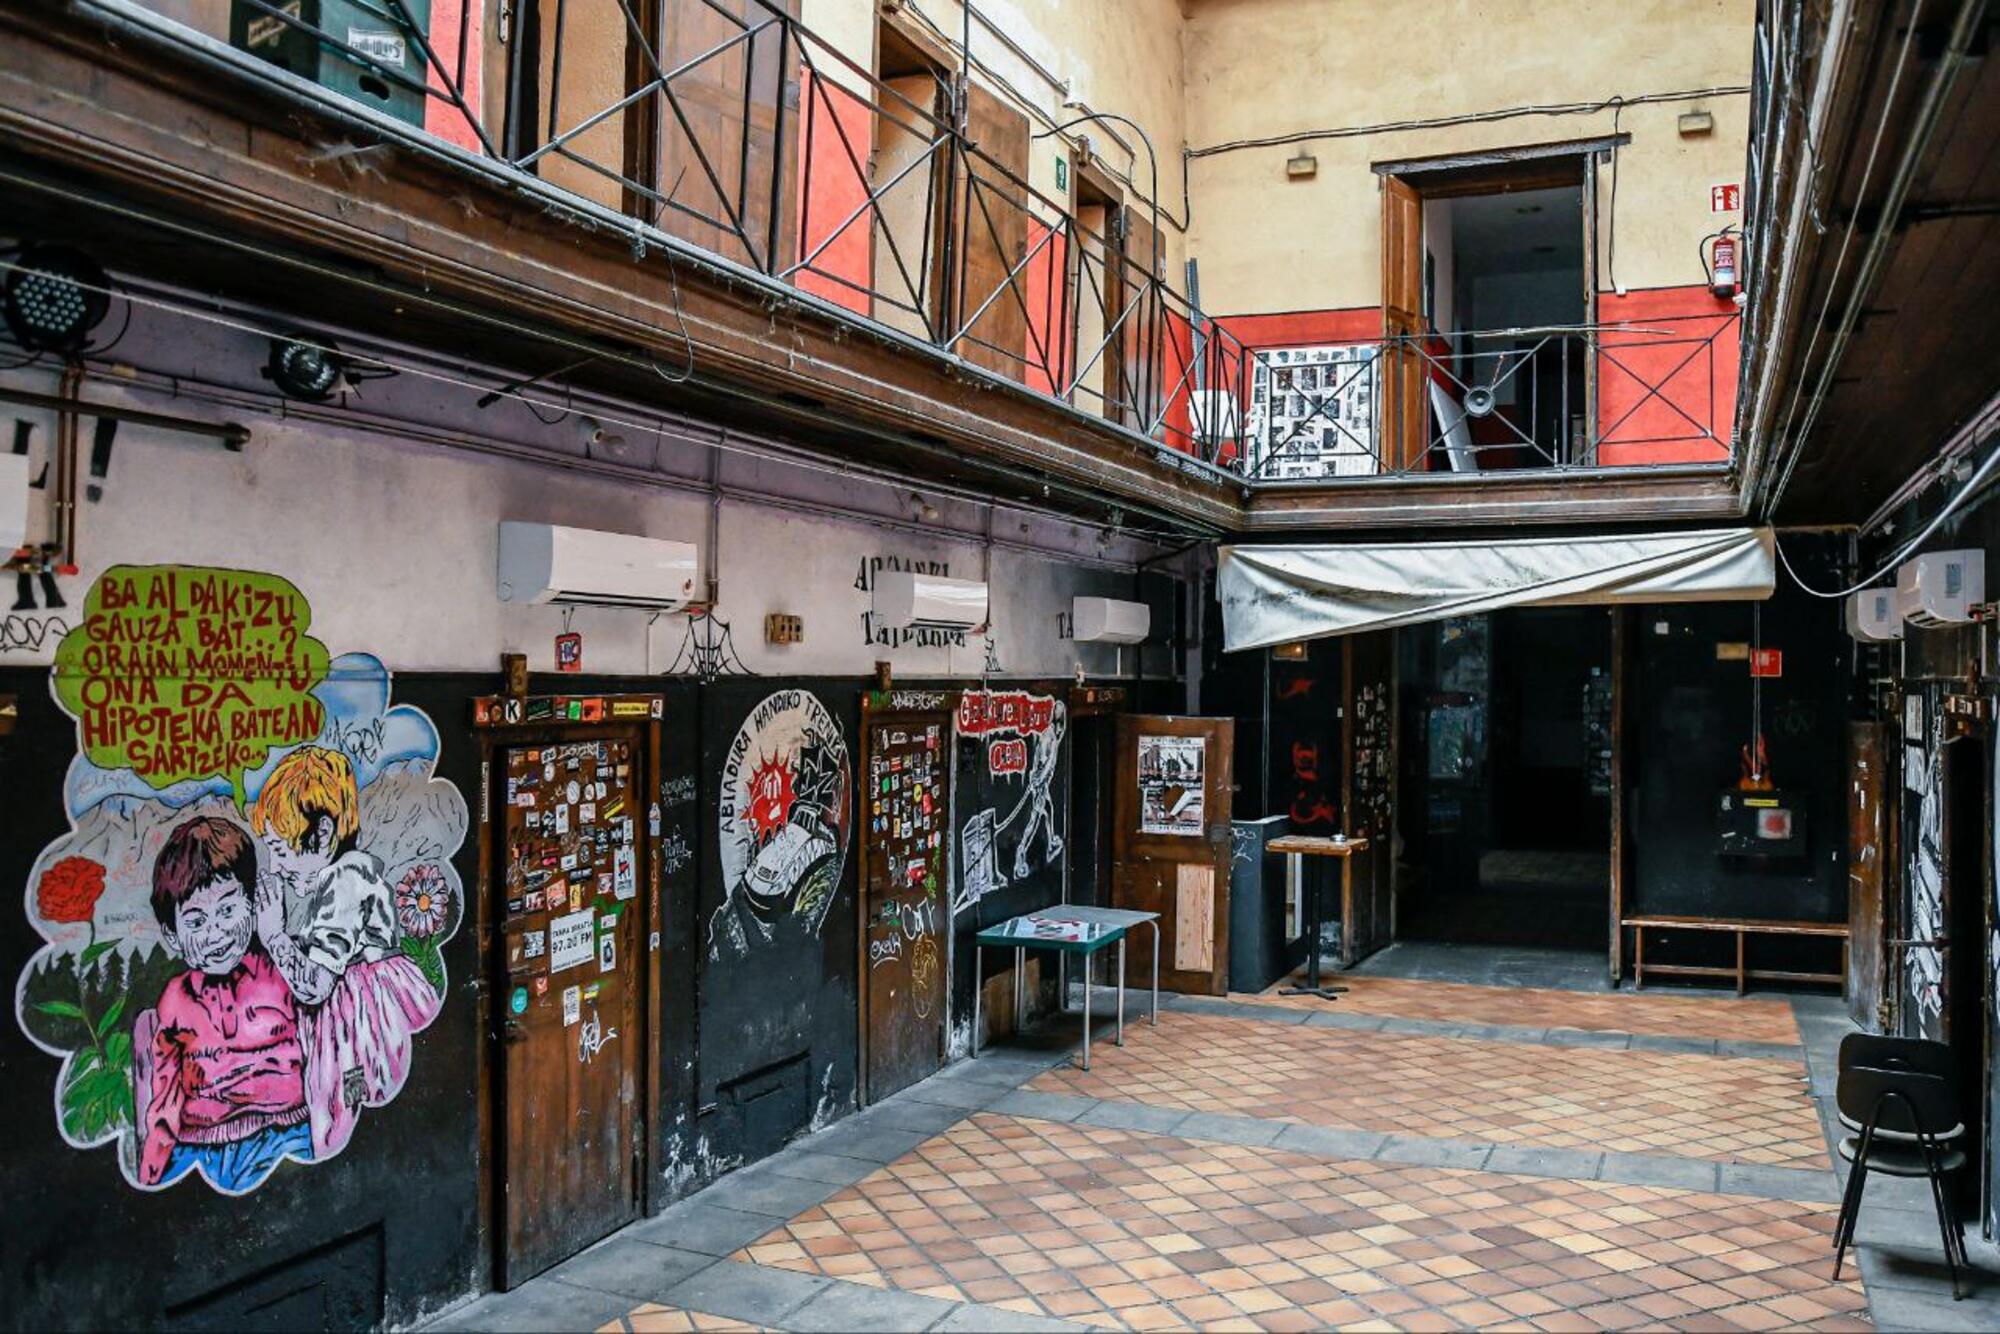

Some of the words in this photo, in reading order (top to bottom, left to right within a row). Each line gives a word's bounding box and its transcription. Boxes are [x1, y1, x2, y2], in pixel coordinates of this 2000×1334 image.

[101, 577, 139, 610] BA
[147, 572, 189, 619] AL
[86, 614, 181, 646] GAUZA
[81, 676, 159, 710] ONA
[181, 682, 254, 709] DA
[753, 692, 801, 732] HANDIKO
[231, 702, 321, 742] BATEAN
